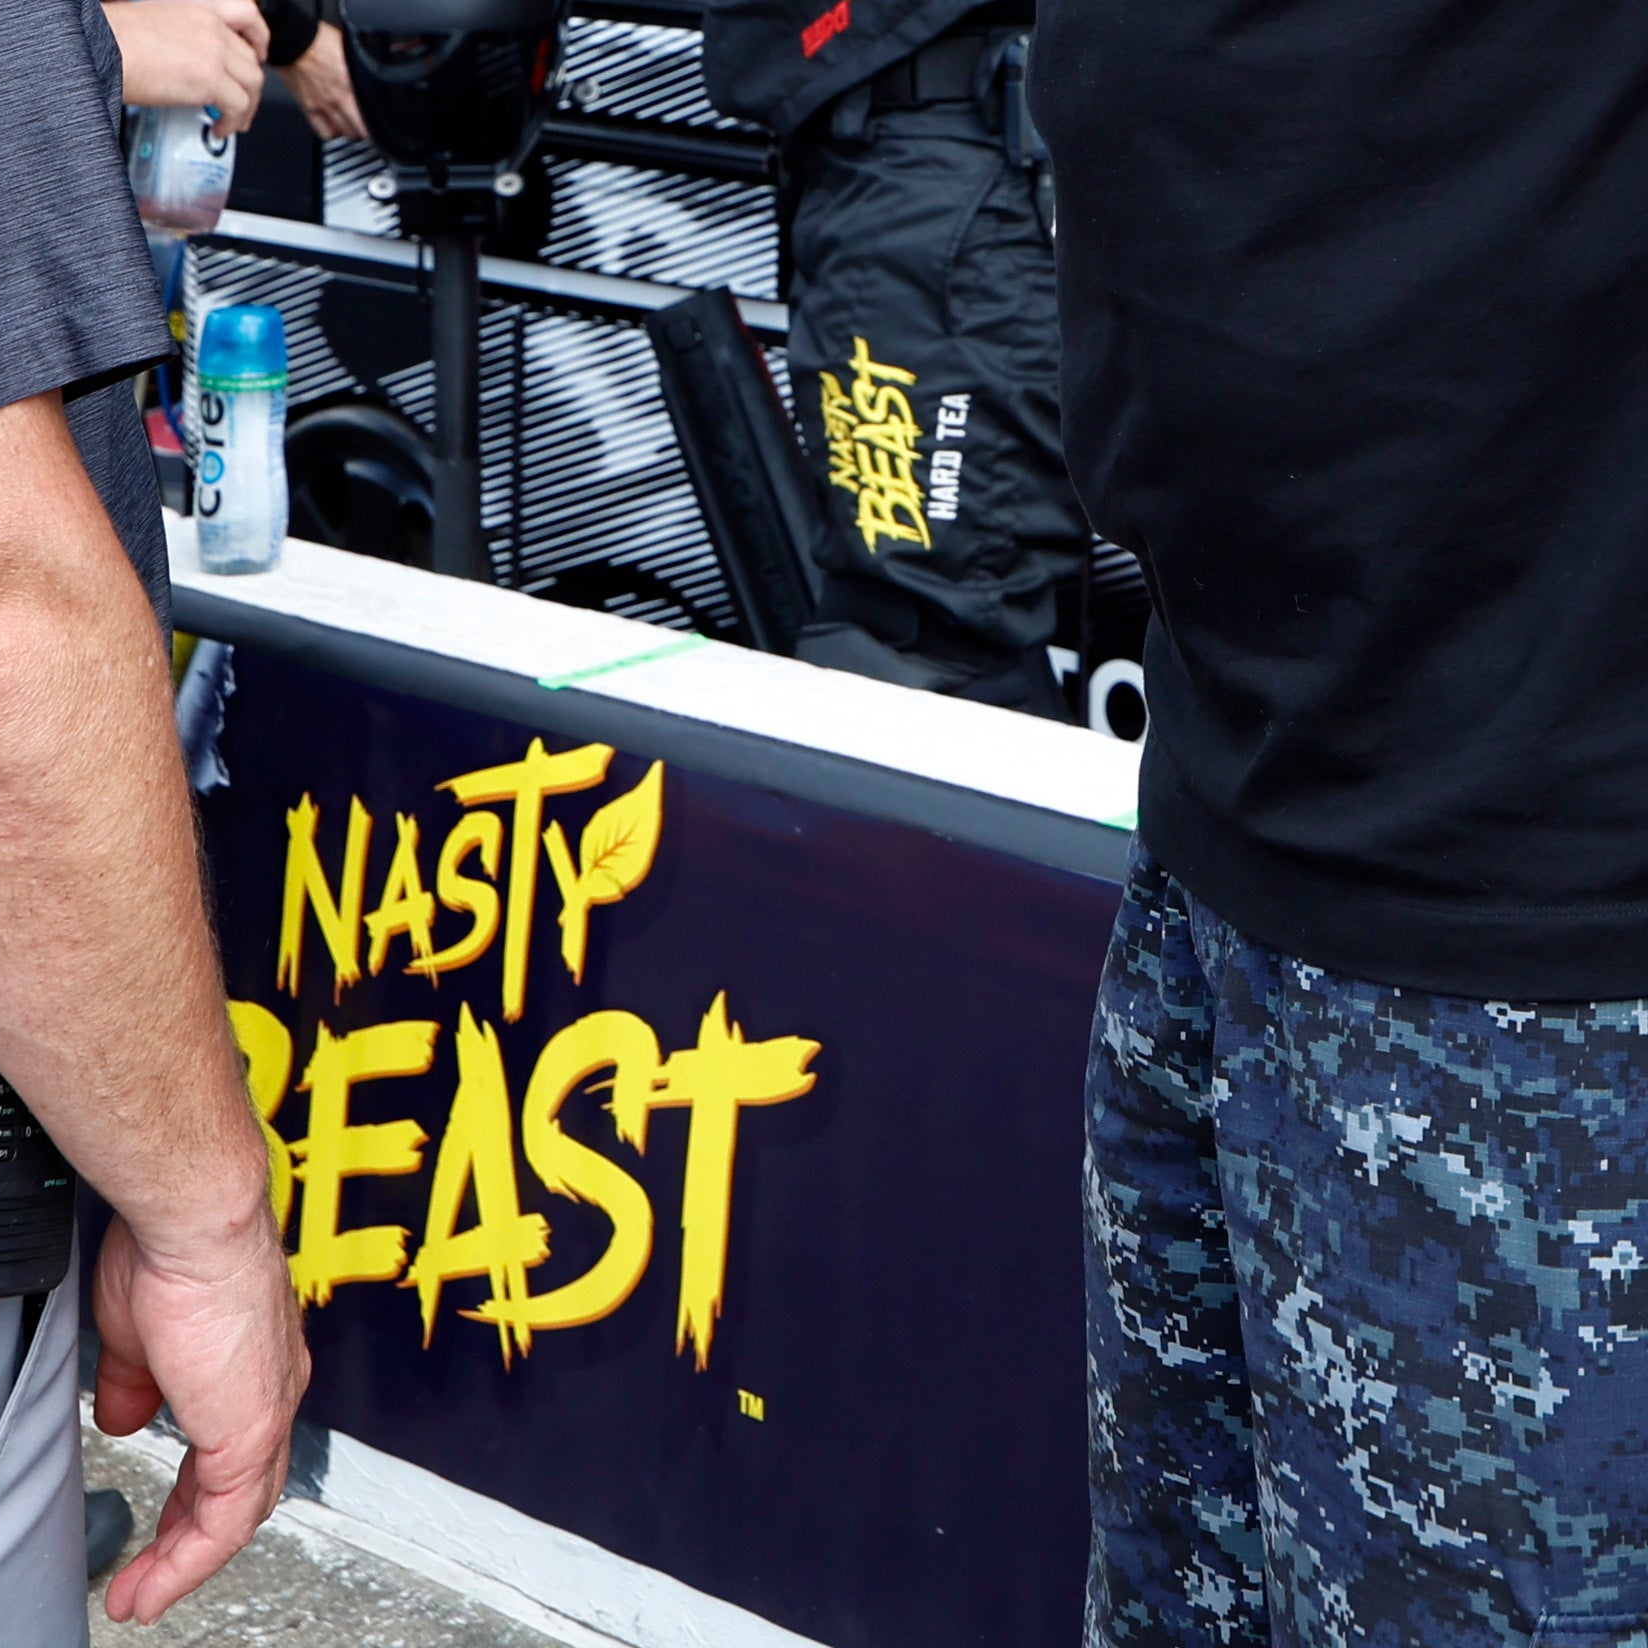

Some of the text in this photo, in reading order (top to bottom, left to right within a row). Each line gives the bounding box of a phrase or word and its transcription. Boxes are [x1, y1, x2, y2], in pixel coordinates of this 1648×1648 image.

[849, 336, 933, 554] BEAST
[926, 393, 972, 521] HARD TEA
[276, 736, 665, 1024] NASTY
[738, 1388, 765, 1421] TM
